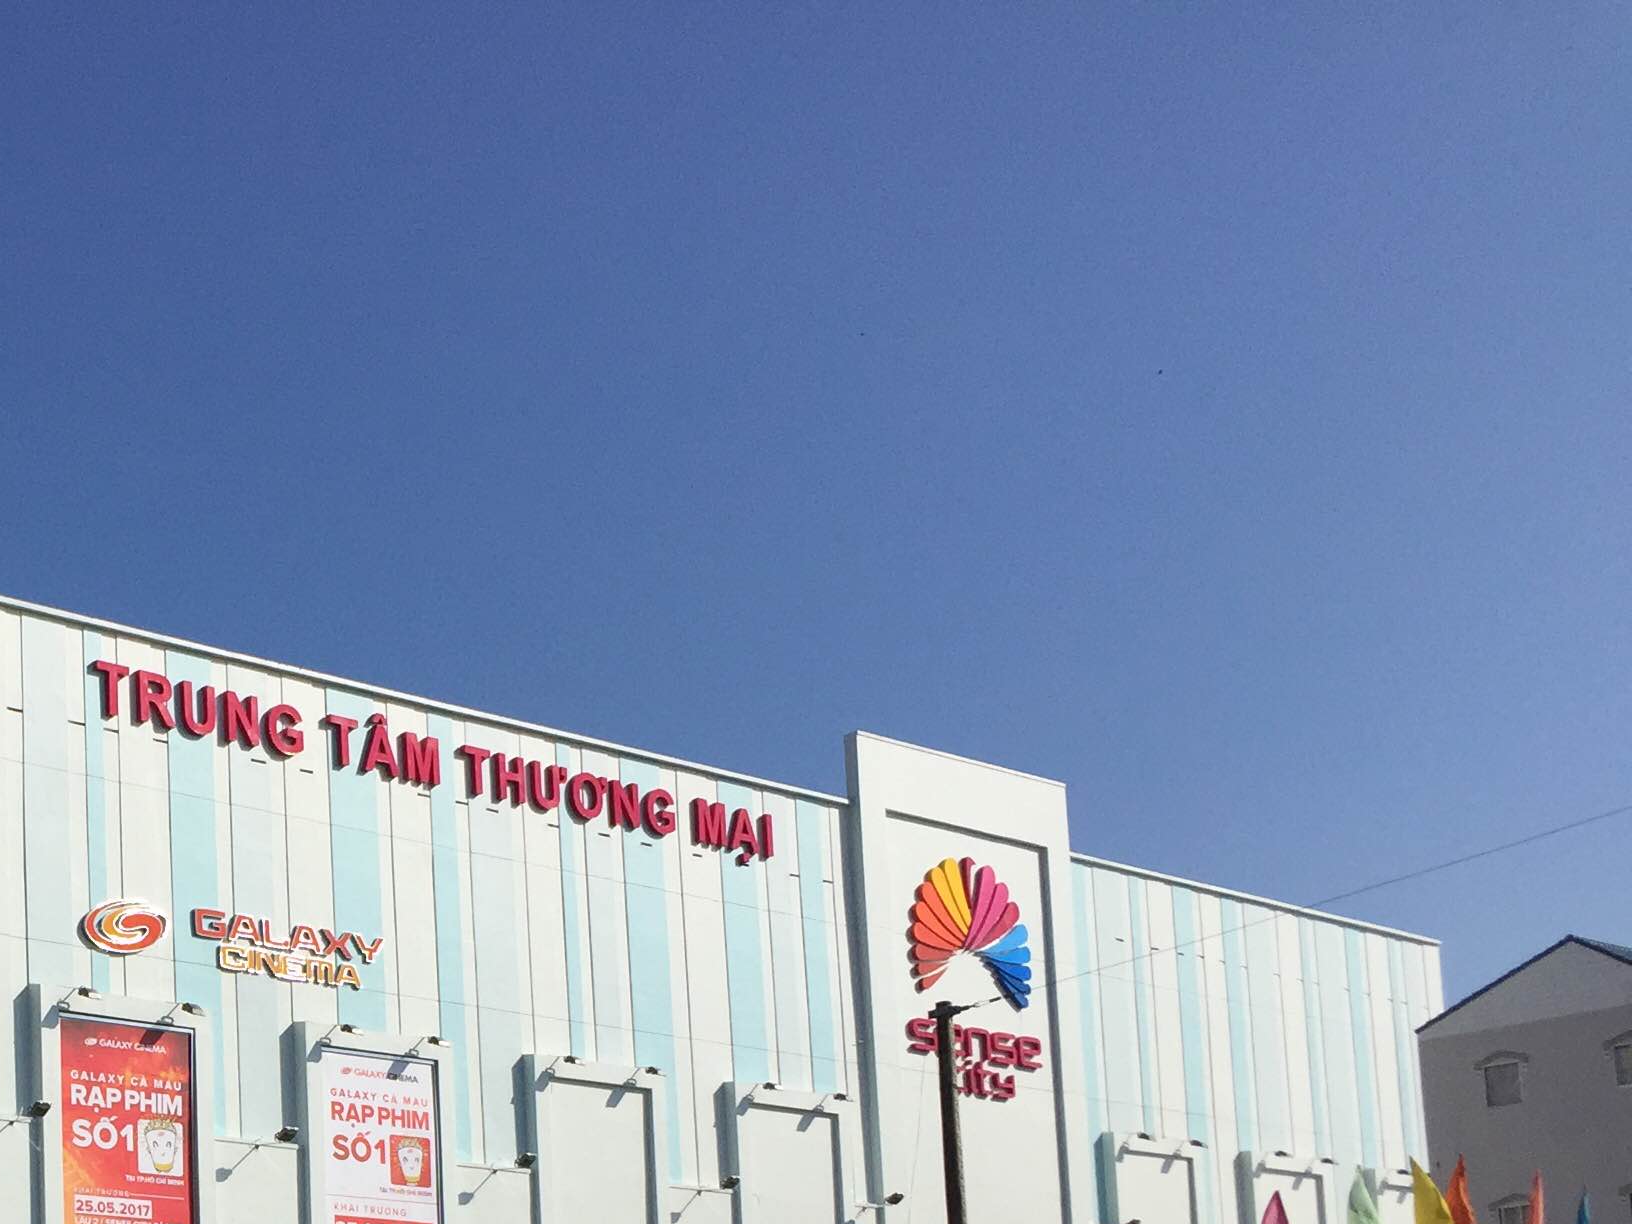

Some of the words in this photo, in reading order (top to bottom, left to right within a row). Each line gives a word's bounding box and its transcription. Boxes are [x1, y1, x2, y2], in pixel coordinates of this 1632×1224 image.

[88, 660, 305, 760] TRUNG
[319, 713, 441, 791] TÂM
[455, 744, 676, 838] THƯƠNG
[690, 797, 774, 866] MẠI
[191, 907, 384, 963] GALAXY
[217, 943, 362, 988] CINEMA
[98, 1038, 132, 1050] GALAXY
[70, 1069, 125, 1085] GALAXY
[153, 1079, 182, 1091] MAU
[353, 1067, 386, 1079] GALAXY
[70, 1083, 122, 1113] RẠP
[124, 1089, 183, 1117] PHIM
[329, 1087, 377, 1102] GALAXY
[402, 1096, 428, 1108] MAU
[330, 1100, 374, 1128] RẠP
[377, 1106, 430, 1131] PHIM
[75, 1199, 151, 1216] 25.05.2017
